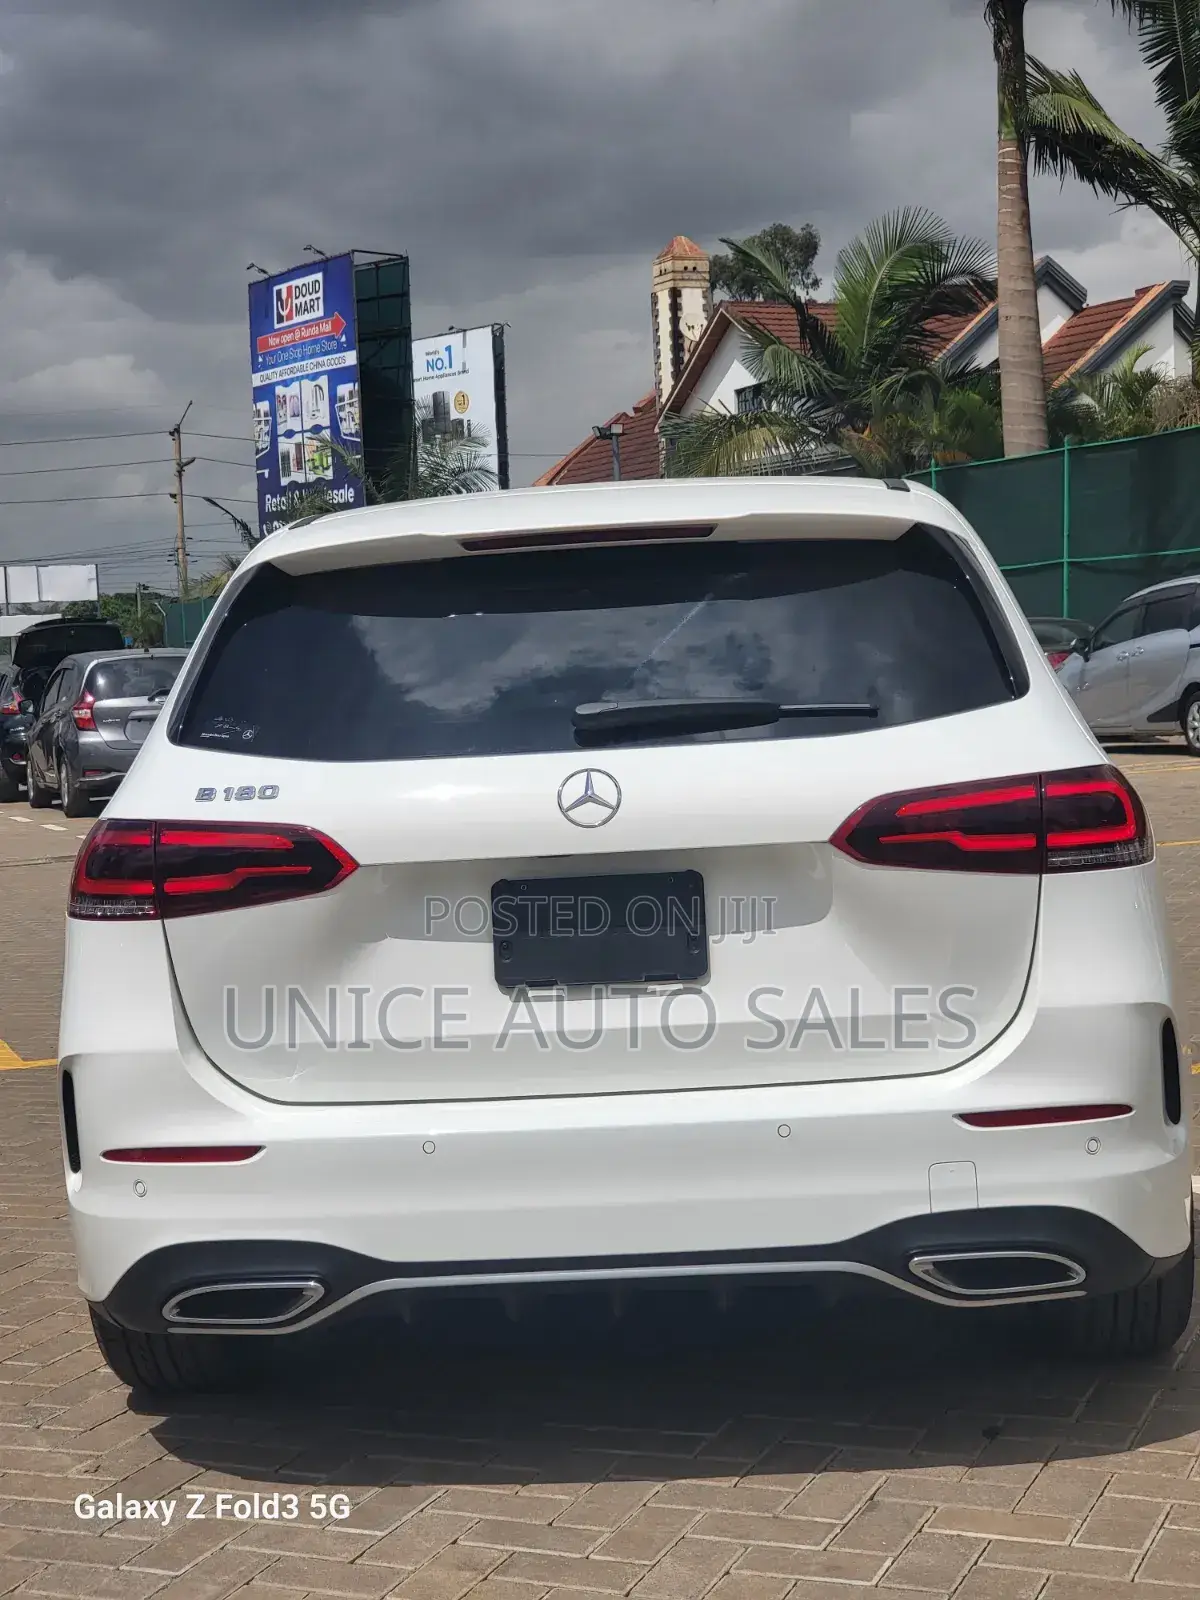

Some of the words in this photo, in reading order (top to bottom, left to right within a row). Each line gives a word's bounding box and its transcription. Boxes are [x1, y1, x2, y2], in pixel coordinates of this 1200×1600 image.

[295, 279, 321, 299] DOUD
[294, 297, 322, 317] MART
[268, 336, 279, 347] Now
[280, 333, 294, 345] open
[301, 325, 319, 337] Runda
[319, 321, 332, 333] Mall
[265, 354, 277, 365] Your
[277, 350, 289, 362] One
[289, 346, 302, 361] Stop
[303, 342, 320, 355] Home
[321, 339, 338, 352] Store
[259, 370, 278, 383] QUALITY
[278, 363, 309, 378] AFFORDABLE
[309, 359, 326, 371] CHINA
[326, 355, 347, 368] GOODS
[195, 787, 217, 802] B
[223, 784, 280, 802] 180
